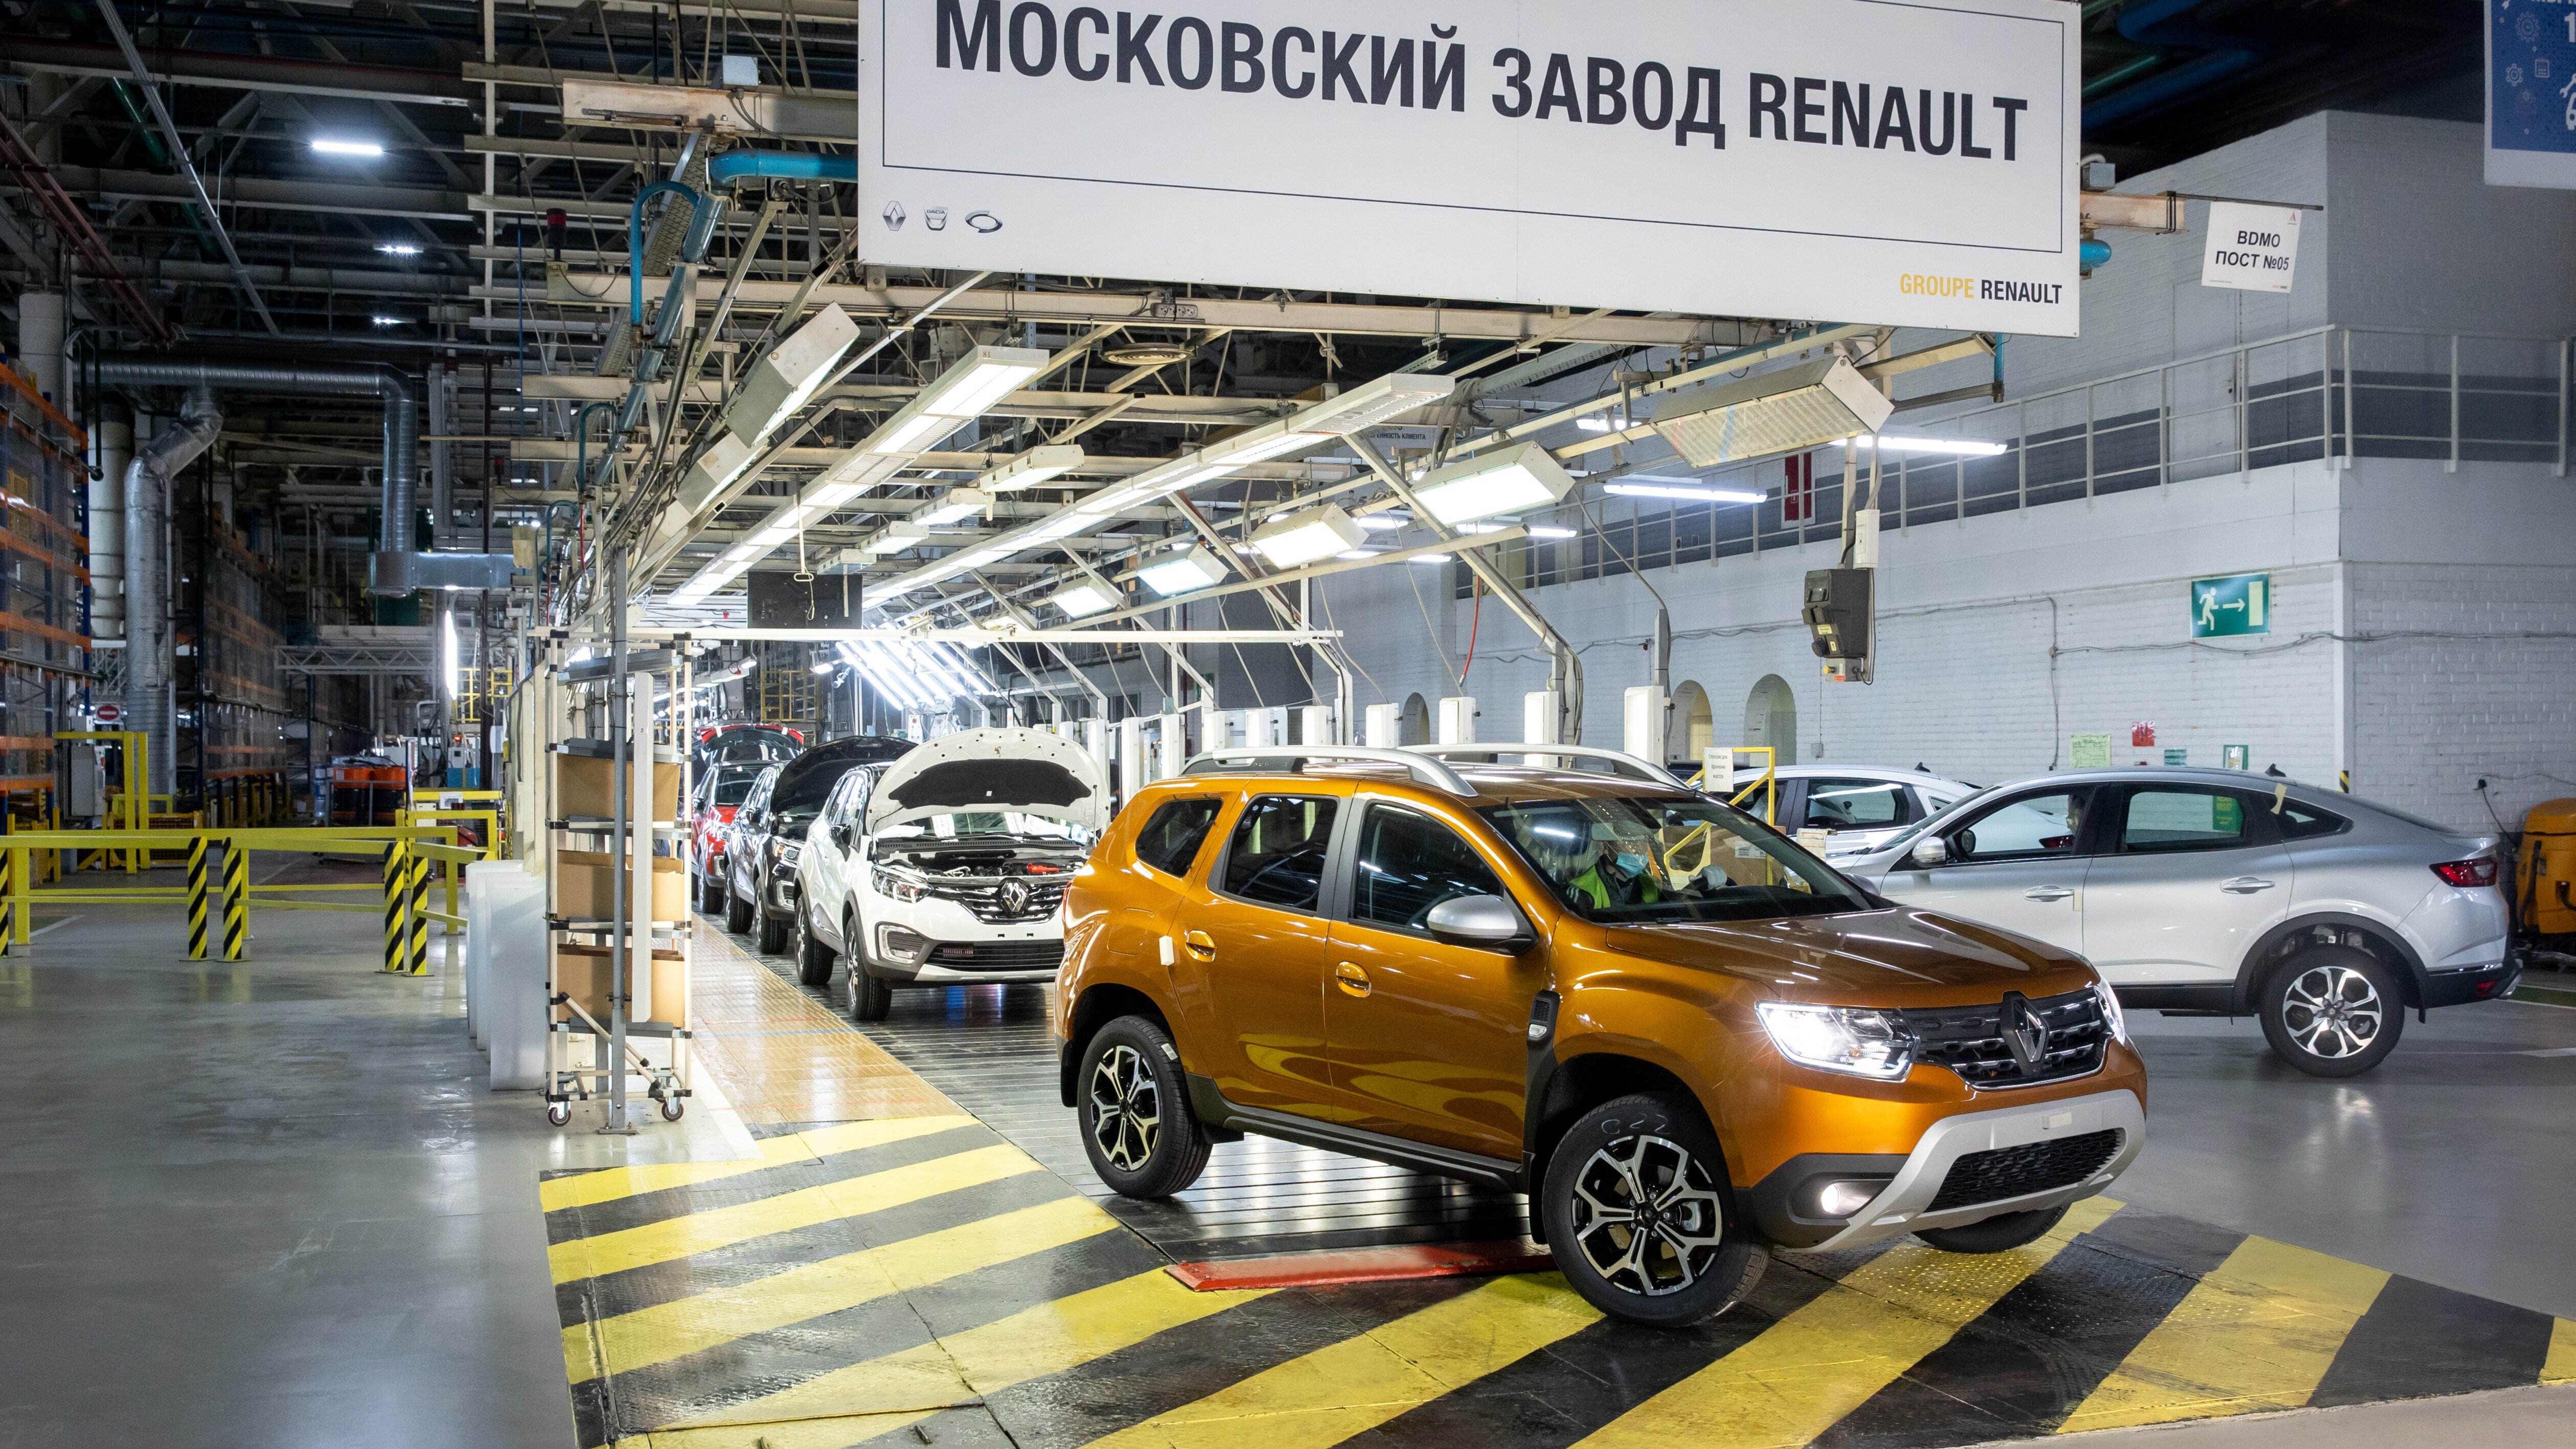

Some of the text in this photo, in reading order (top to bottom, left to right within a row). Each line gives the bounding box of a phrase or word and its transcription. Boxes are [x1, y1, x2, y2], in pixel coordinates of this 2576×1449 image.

[937, 0, 2027, 161] МОСКОВСКИЙ ЗАВОД RENAULT
[2237, 230, 2281, 247] BDMO
[2216, 251, 2289, 270] ПОСТ №05
[1900, 273, 2062, 304] GROUPE RENAULT
